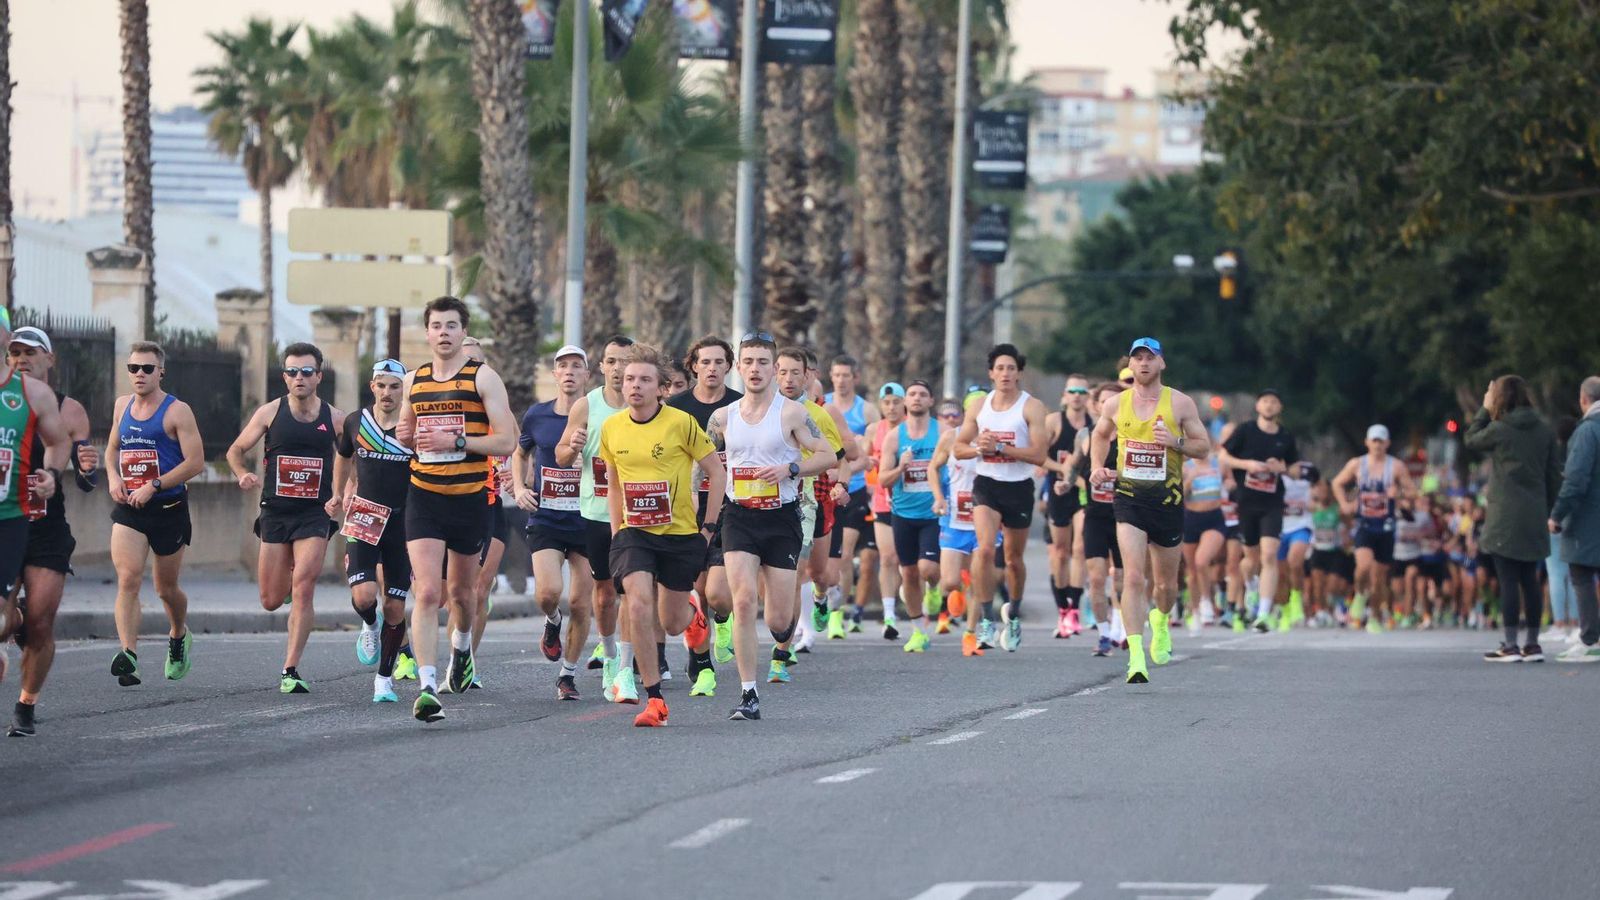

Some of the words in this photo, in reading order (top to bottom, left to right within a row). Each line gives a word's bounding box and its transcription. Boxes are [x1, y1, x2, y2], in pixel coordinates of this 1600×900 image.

[416, 402, 463, 412] BLAYDON
[1131, 454, 1156, 463] 16874
[128, 464, 147, 473] 4460
[289, 471, 311, 480] 7057
[550, 483, 575, 492] 17240
[632, 483, 665, 491] GENERALI
[633, 498, 657, 507] 7873
[353, 511, 374, 525] 3136
